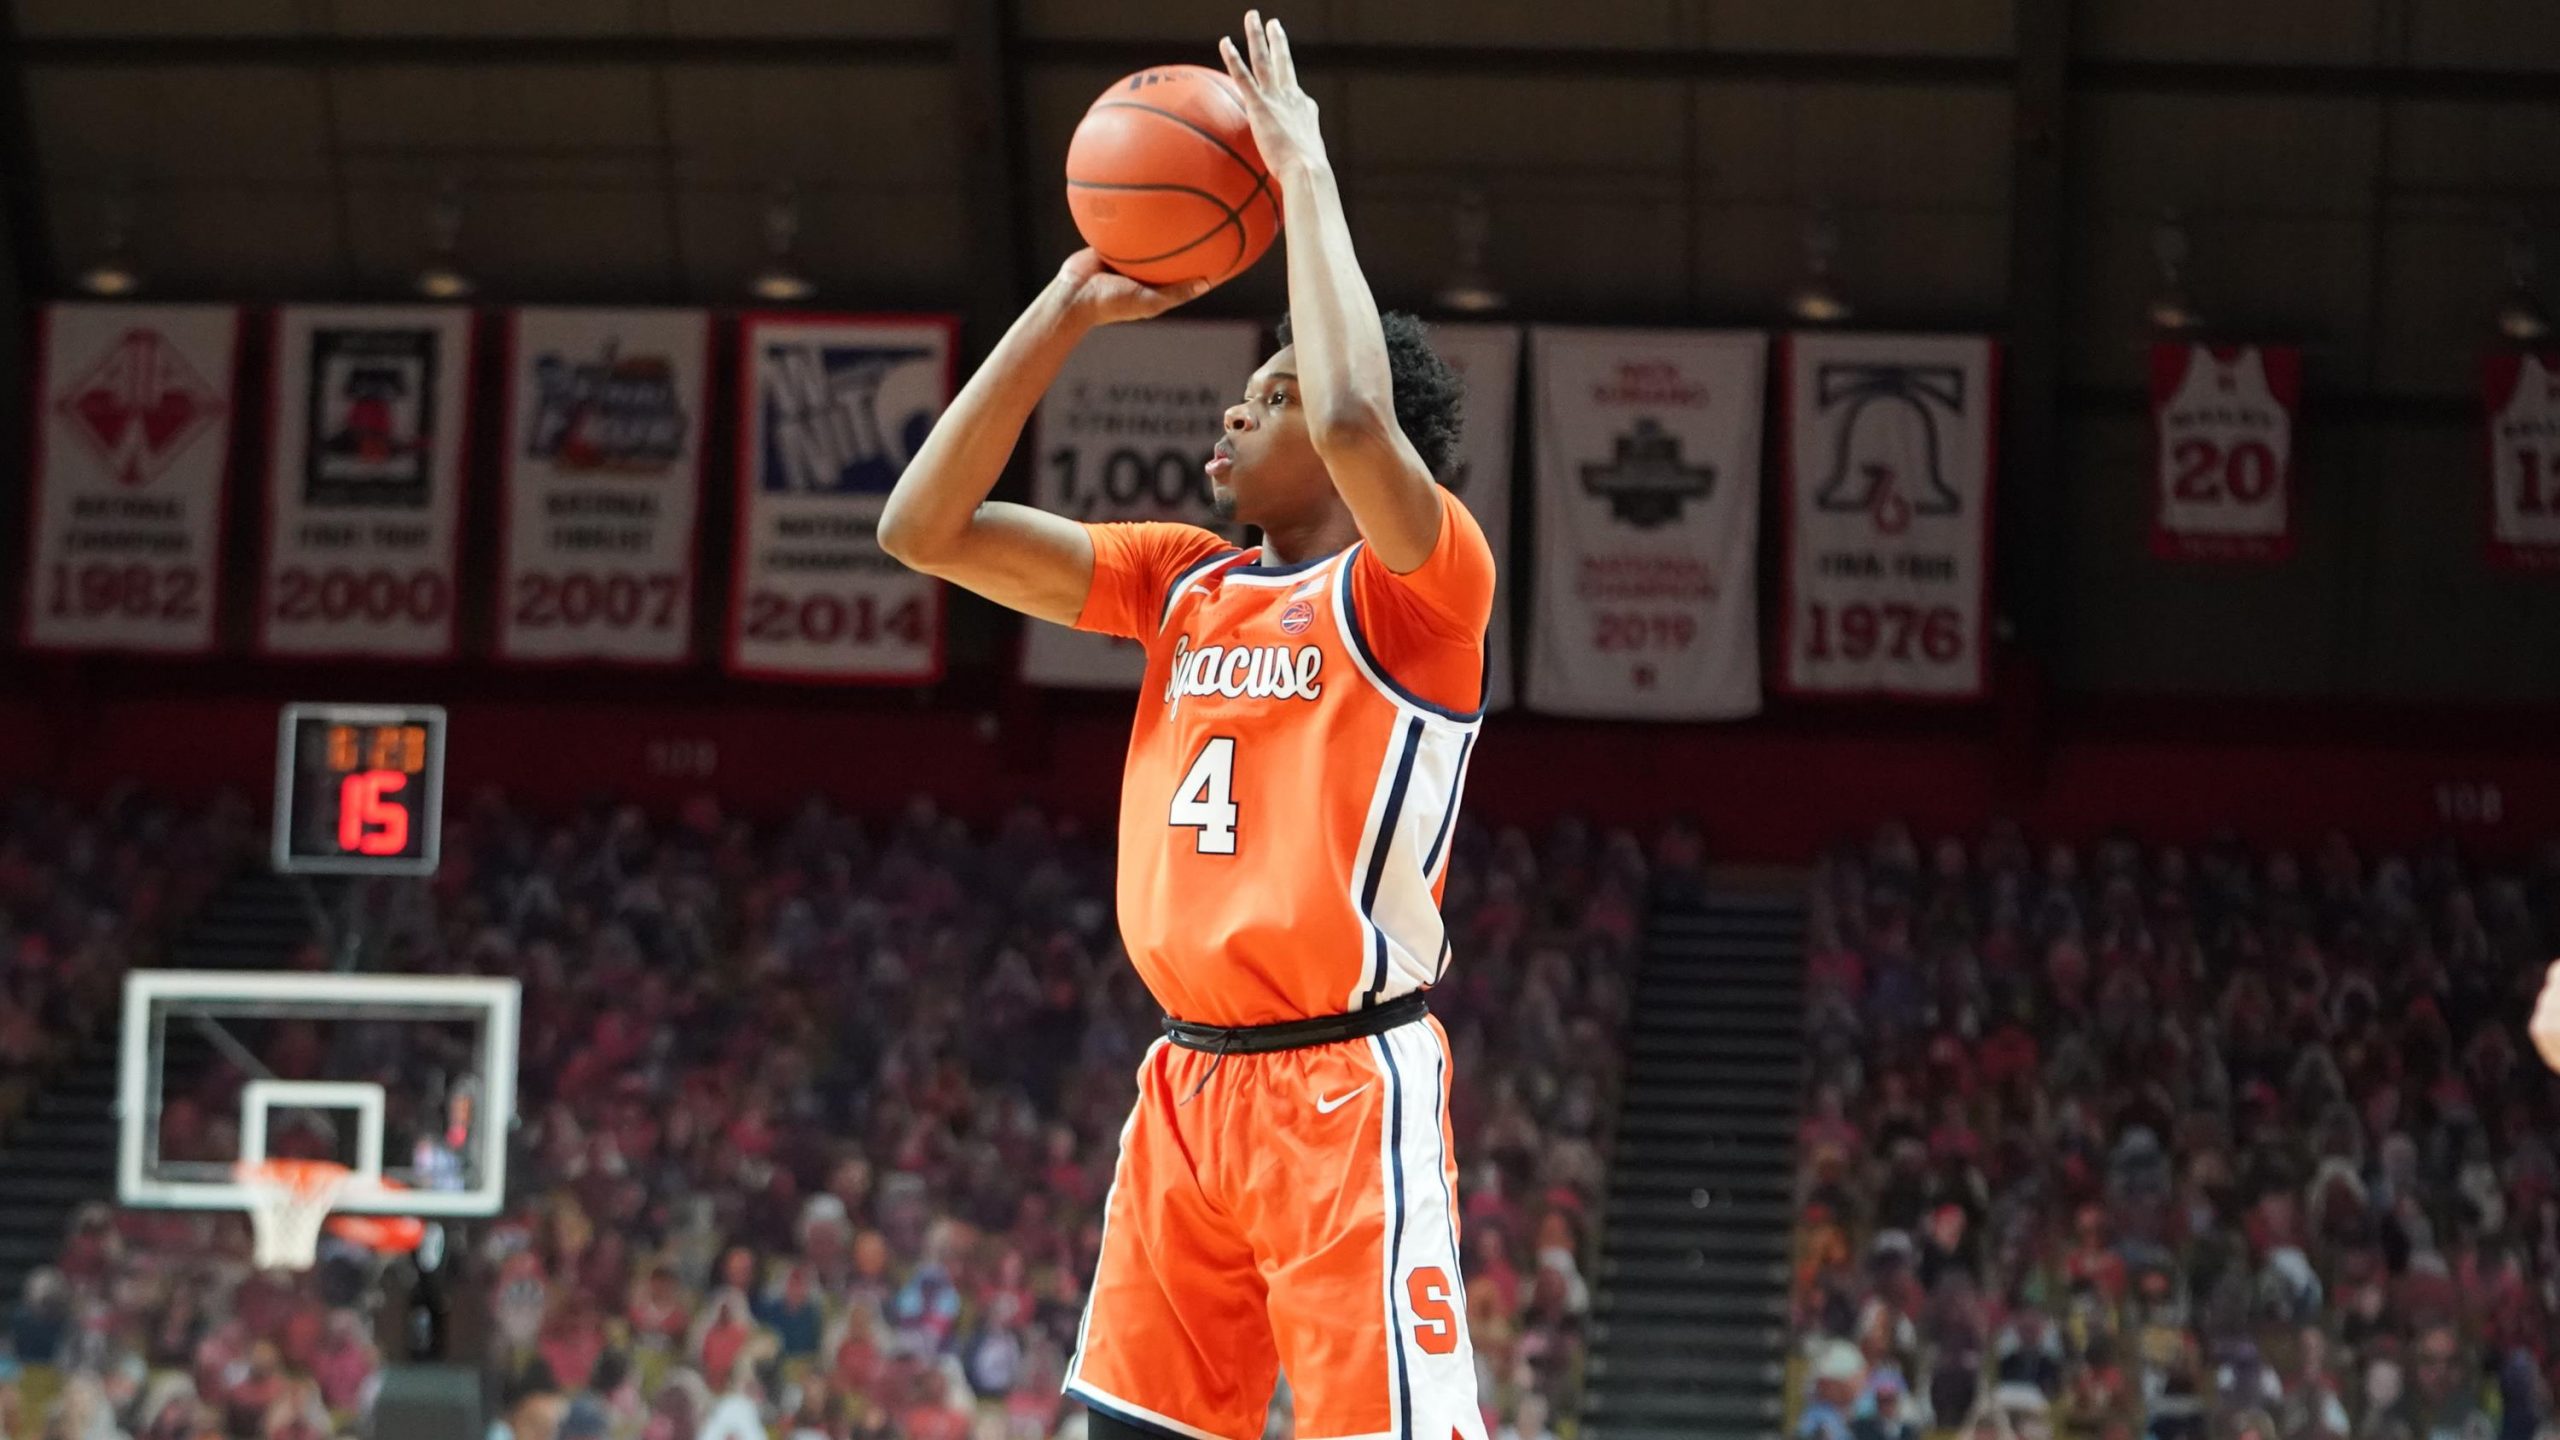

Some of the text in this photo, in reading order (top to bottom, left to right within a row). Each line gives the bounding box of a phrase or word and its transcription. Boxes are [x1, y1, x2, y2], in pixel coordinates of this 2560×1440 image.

[2171, 436, 2277, 506] 20
[2517, 449, 2560, 515] 1
[48, 563, 201, 620] 1982
[277, 565, 450, 624] 2000
[514, 571, 685, 630] 2007
[745, 592, 928, 644] 2014
[1806, 601, 1965, 663] 1976
[339, 770, 409, 856] 15
[1168, 735, 1239, 855] 4
[1406, 1266, 1458, 1356] S
